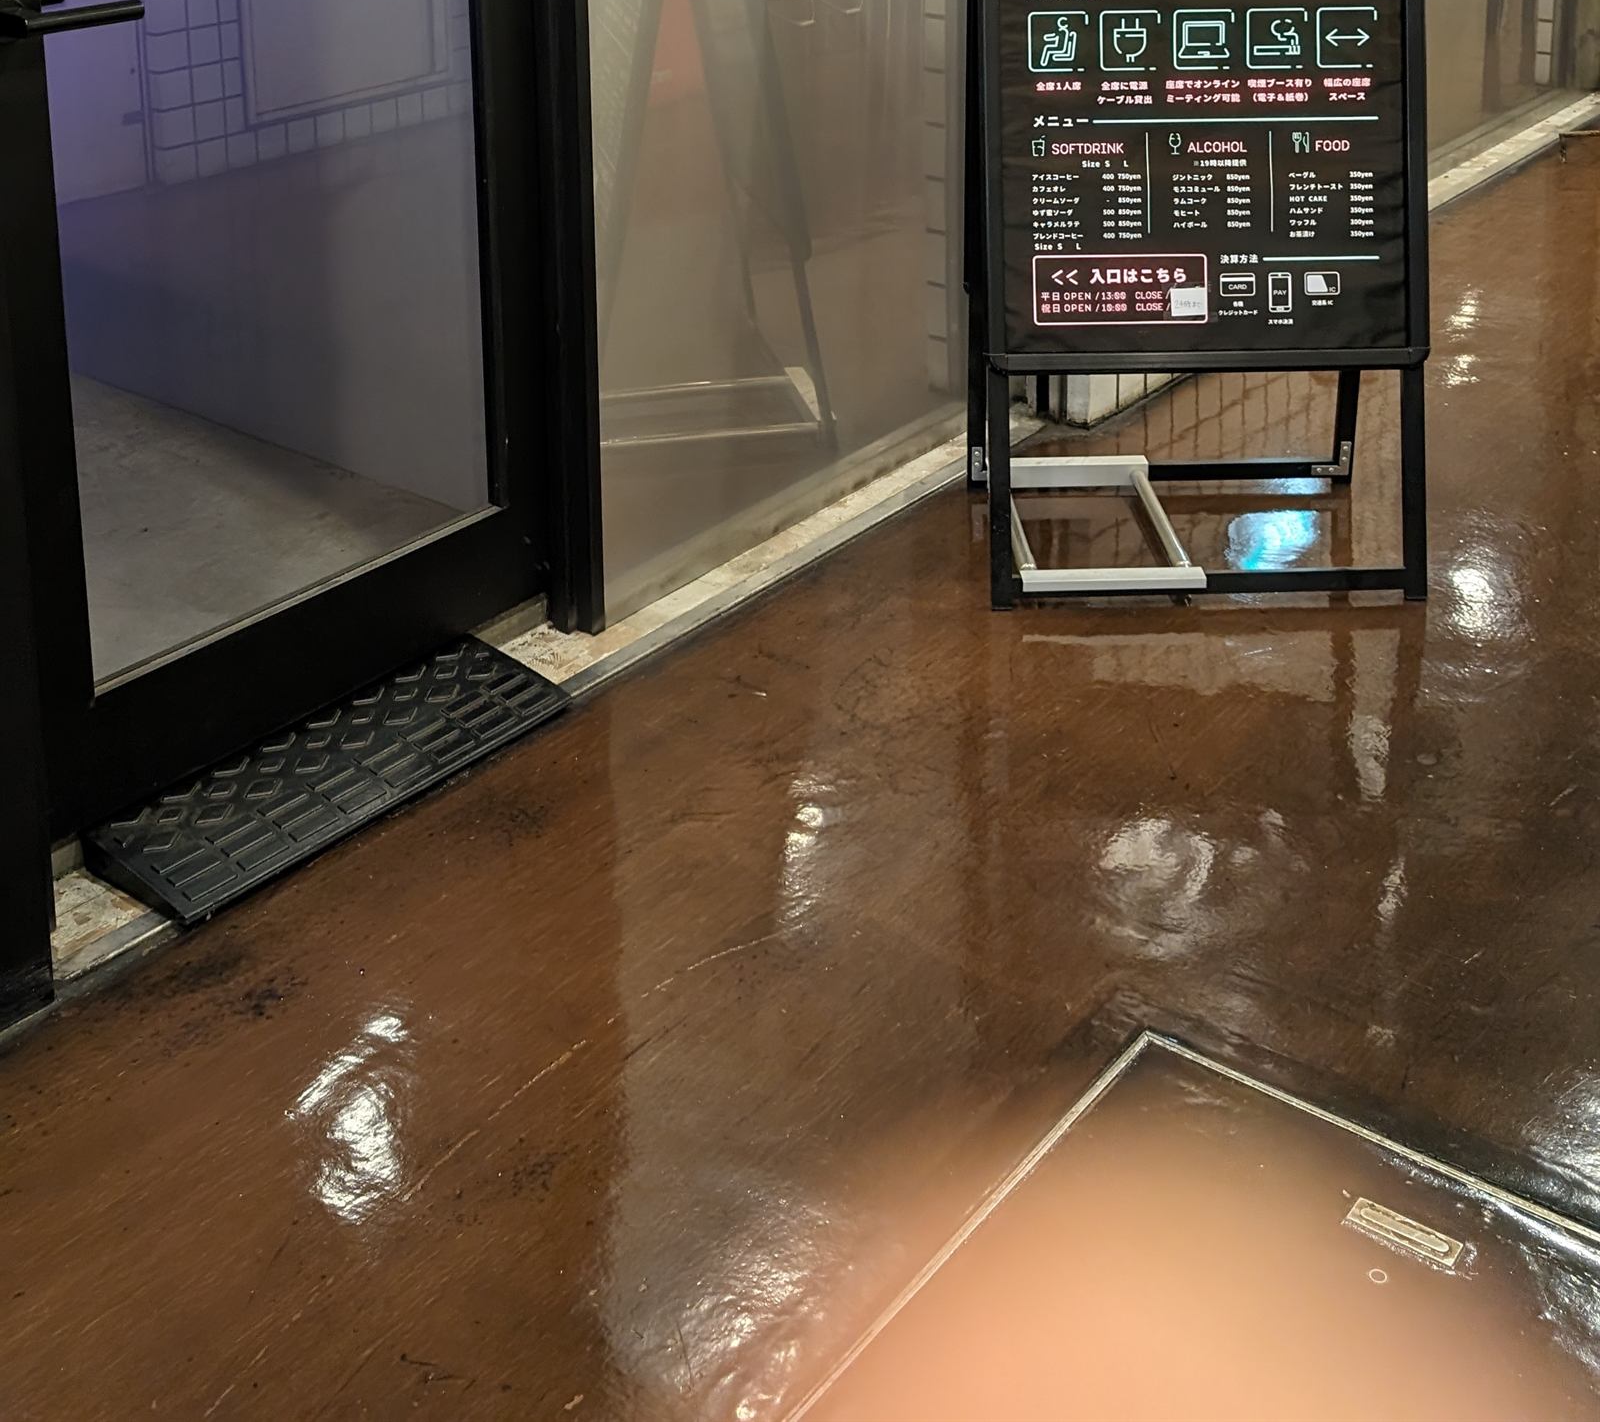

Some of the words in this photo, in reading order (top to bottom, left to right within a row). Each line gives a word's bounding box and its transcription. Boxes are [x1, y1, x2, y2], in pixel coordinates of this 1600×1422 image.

[1036, 81, 1082, 91] 全席1人席
[1101, 81, 1148, 91] 全席に電源
[1165, 79, 1240, 89] 座席でオンライン
[1247, 78, 1312, 88] 喫煙ブース有り
[1323, 78, 1371, 87] 幅広の座席
[1096, 95, 1153, 105] ケーブル貸出
[1166, 93, 1241, 104] ミーティング可能
[1329, 92, 1366, 101] スペース
[1033, 115, 1089, 128] メニュー
[1051, 142, 1124, 155] SOFTDRINK
[1187, 141, 1247, 153] ALCOHOL
[1315, 140, 1350, 151] FOOD
[1081, 160, 1100, 168] Size
[1105, 160, 1110, 168] S
[1032, 197, 1080, 205] クリームソーダ
[1033, 232, 1083, 240] ブレンドコーヒー
[1034, 243, 1053, 251] Size
[1220, 254, 1258, 264] 決算方法
[1090, 268, 1186, 284] 入口はこちら
[1040, 292, 1060, 301] 平日
[1064, 292, 1092, 300] OPEN
[1135, 291, 1163, 299] CLOSE
[1041, 304, 1060, 313] 祝日
[1064, 304, 1092, 312] OPEN
[1136, 303, 1163, 311] CLOSE
